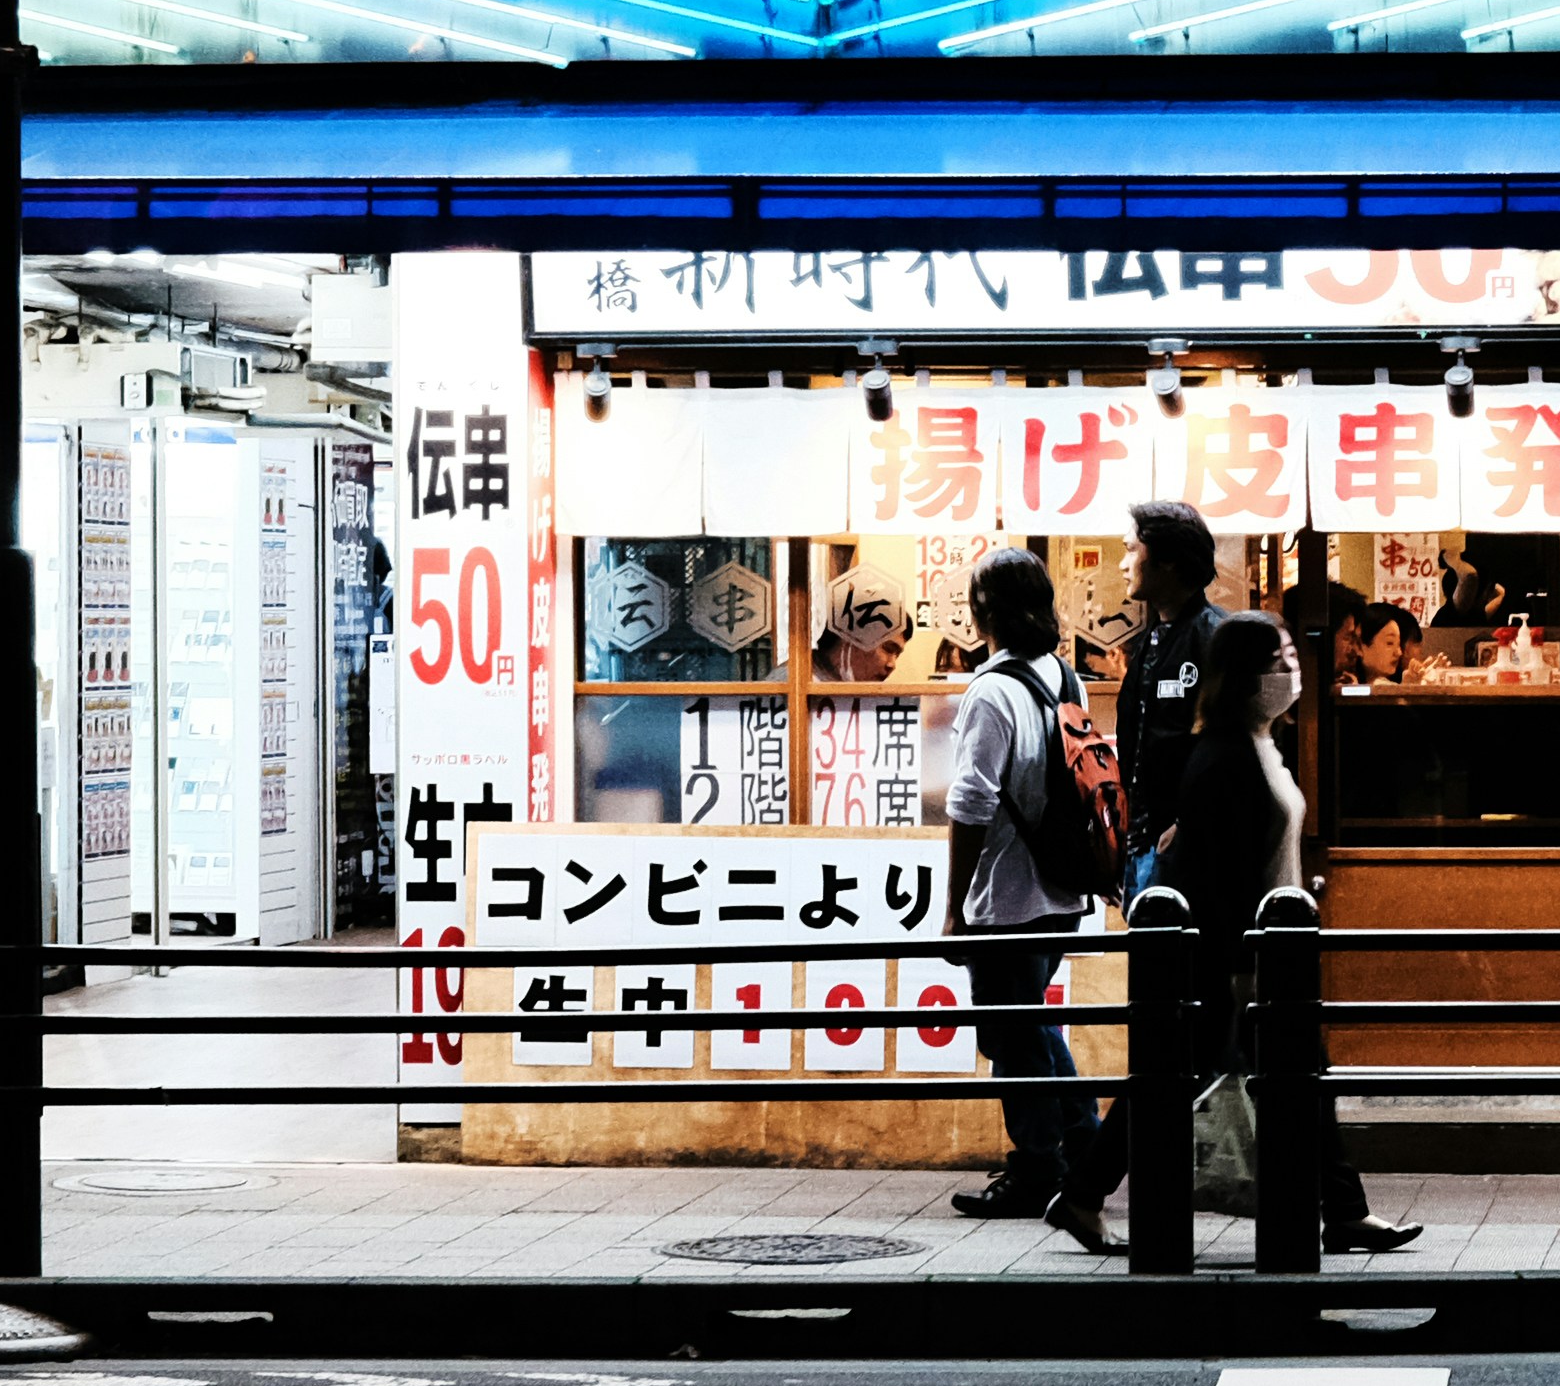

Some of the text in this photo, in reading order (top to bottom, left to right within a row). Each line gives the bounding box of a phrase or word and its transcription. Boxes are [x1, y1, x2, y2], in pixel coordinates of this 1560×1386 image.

[406, 403, 511, 522] 伝串
[409, 545, 516, 687] 50円
[411, 753, 509, 766] サッポロ黒ラベル
[683, 695, 920, 772] 1階 34席
[486, 858, 935, 933] コンビニより
